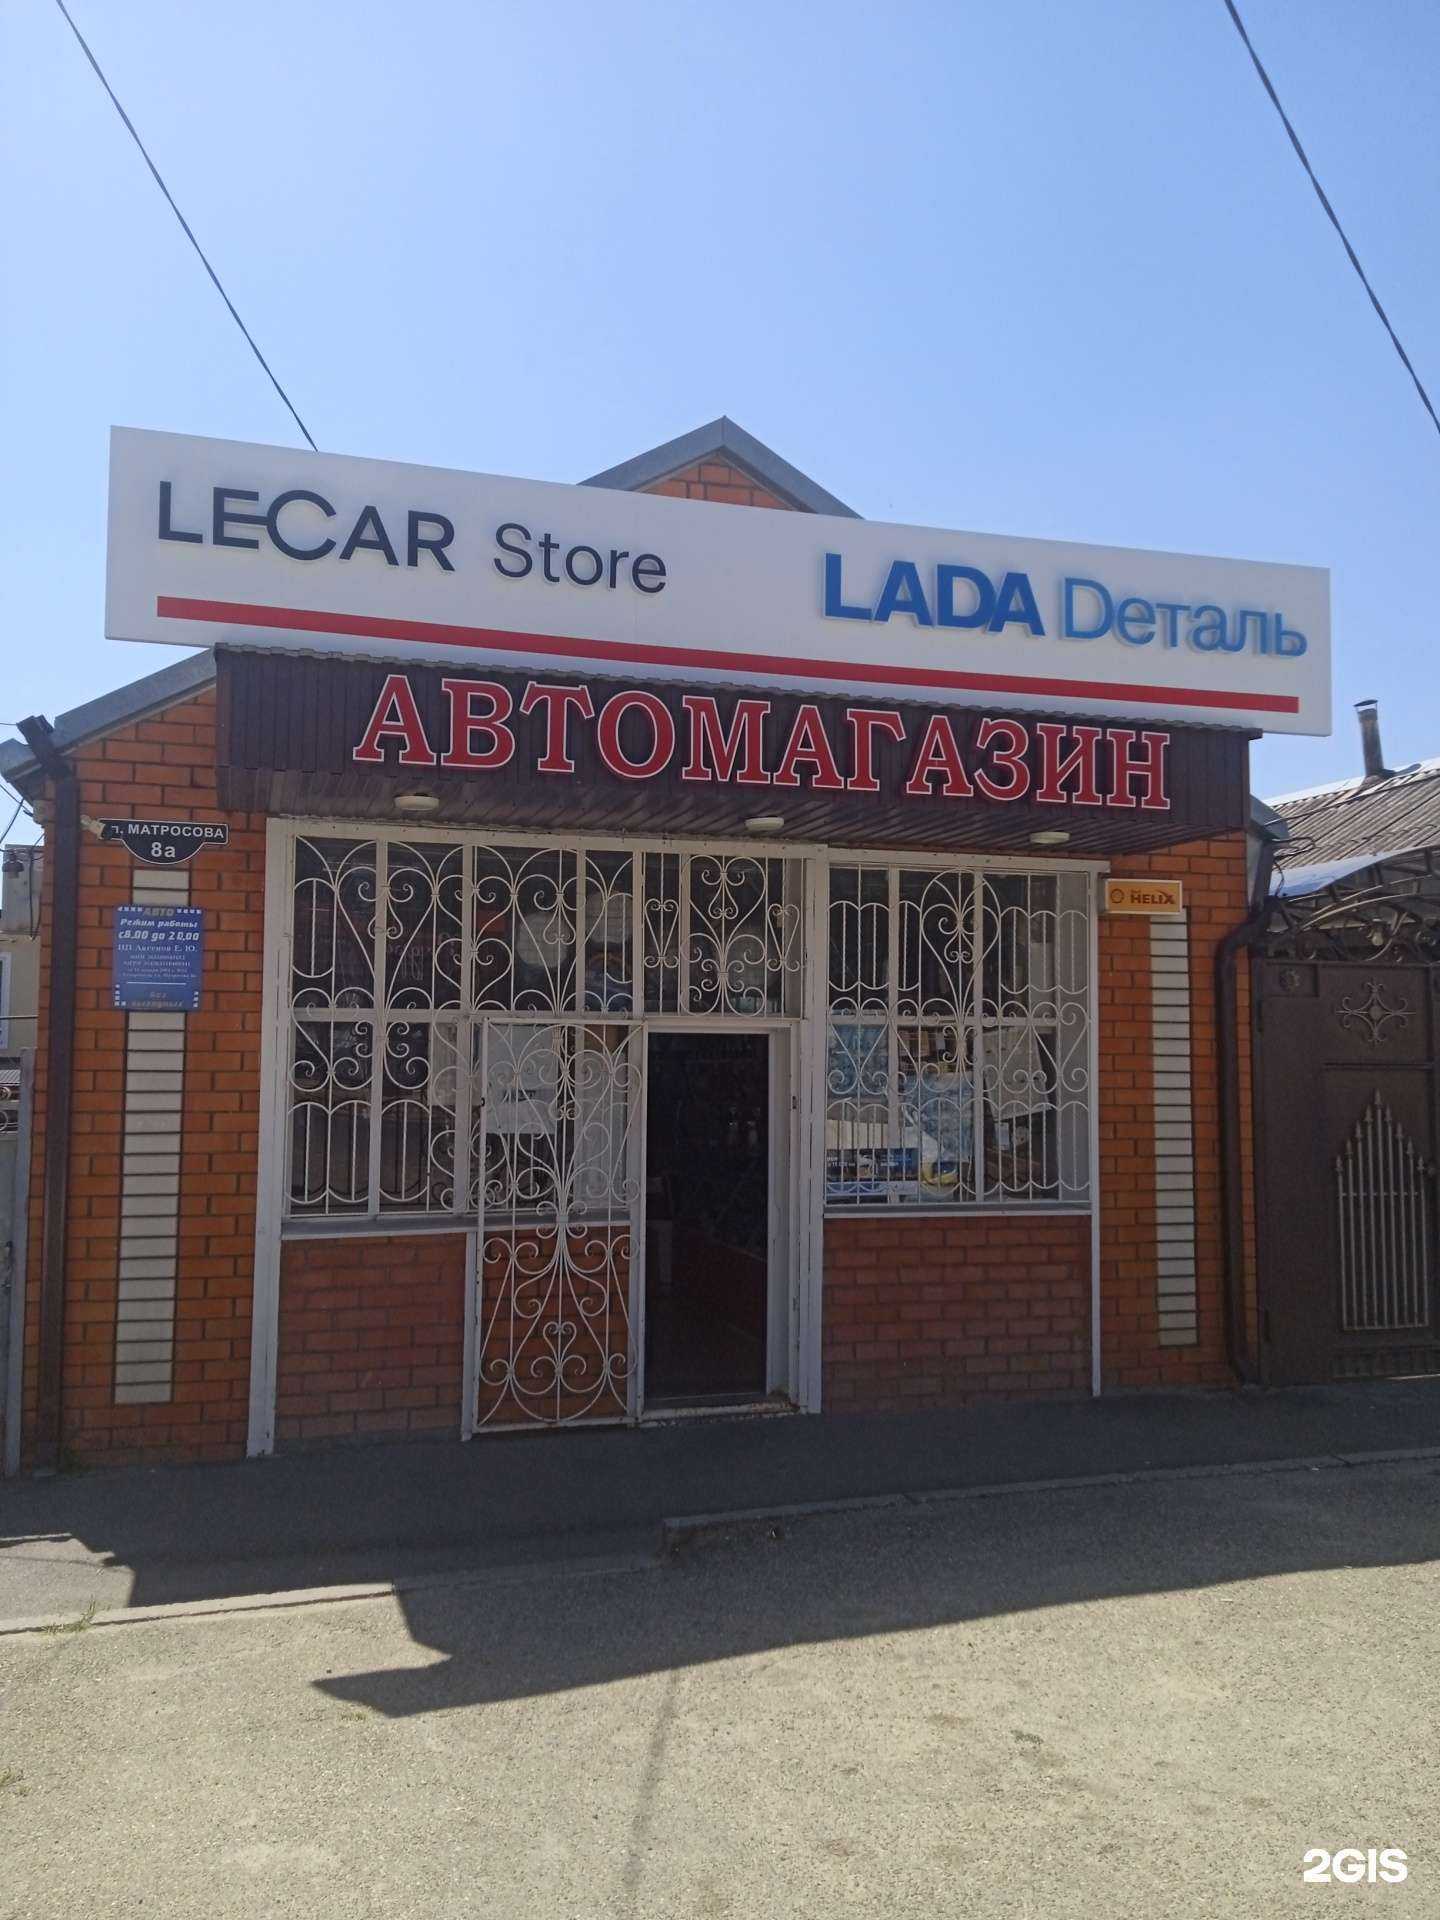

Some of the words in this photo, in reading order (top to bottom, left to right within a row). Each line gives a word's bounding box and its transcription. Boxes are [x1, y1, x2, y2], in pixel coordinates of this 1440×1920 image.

[158, 481, 456, 572] LECAR
[493, 522, 668, 594] Store
[823, 552, 1046, 637] LADA
[352, 673, 1172, 810] АВТОМАГАЗИН
[128, 823, 224, 838] МАТРОСОВА
[151, 841, 176, 858] 8а
[1130, 892, 1176, 905] HELIX
[120, 918, 155, 927] Режим
[157, 920, 198, 928] работы
[151, 932, 166, 942] до
